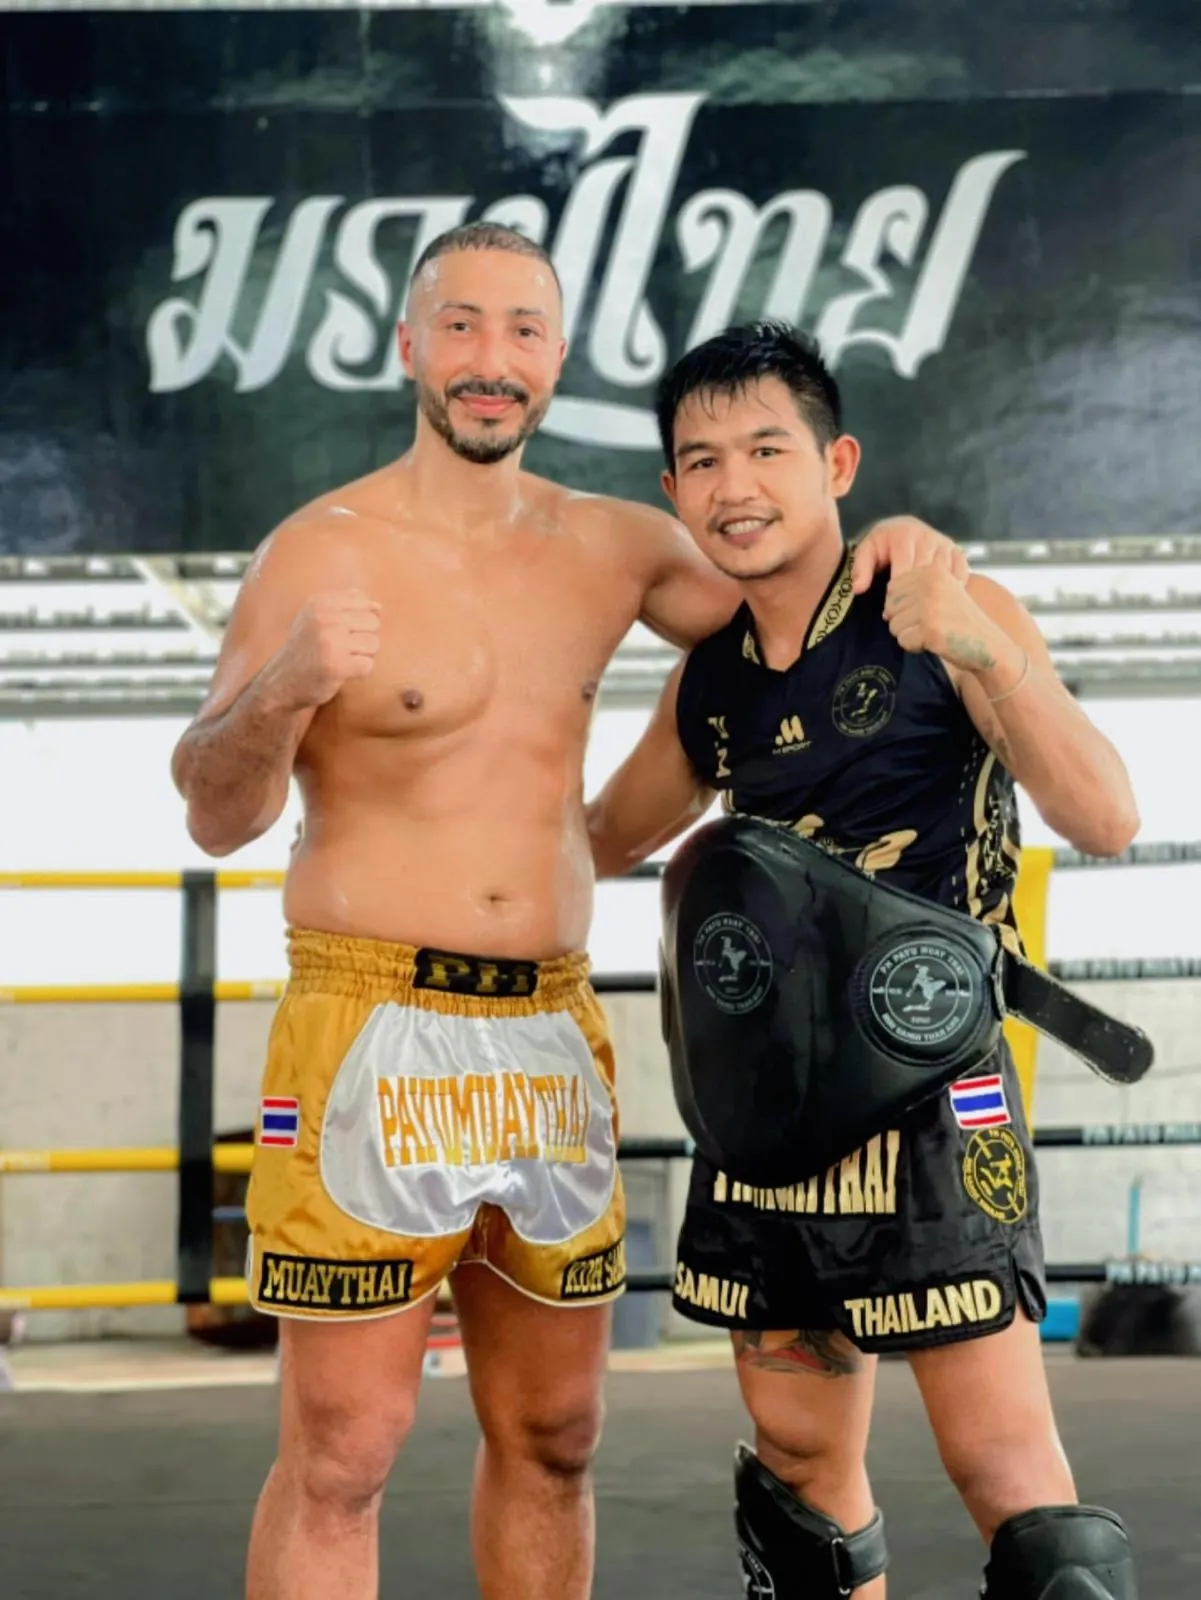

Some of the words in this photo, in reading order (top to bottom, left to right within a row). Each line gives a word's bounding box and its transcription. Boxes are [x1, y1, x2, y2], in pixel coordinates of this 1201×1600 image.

[263, 1258, 408, 1304] MUAYTHAI
[675, 1261, 749, 1319] SAMUI
[844, 1279, 1001, 1338] THAILAND
